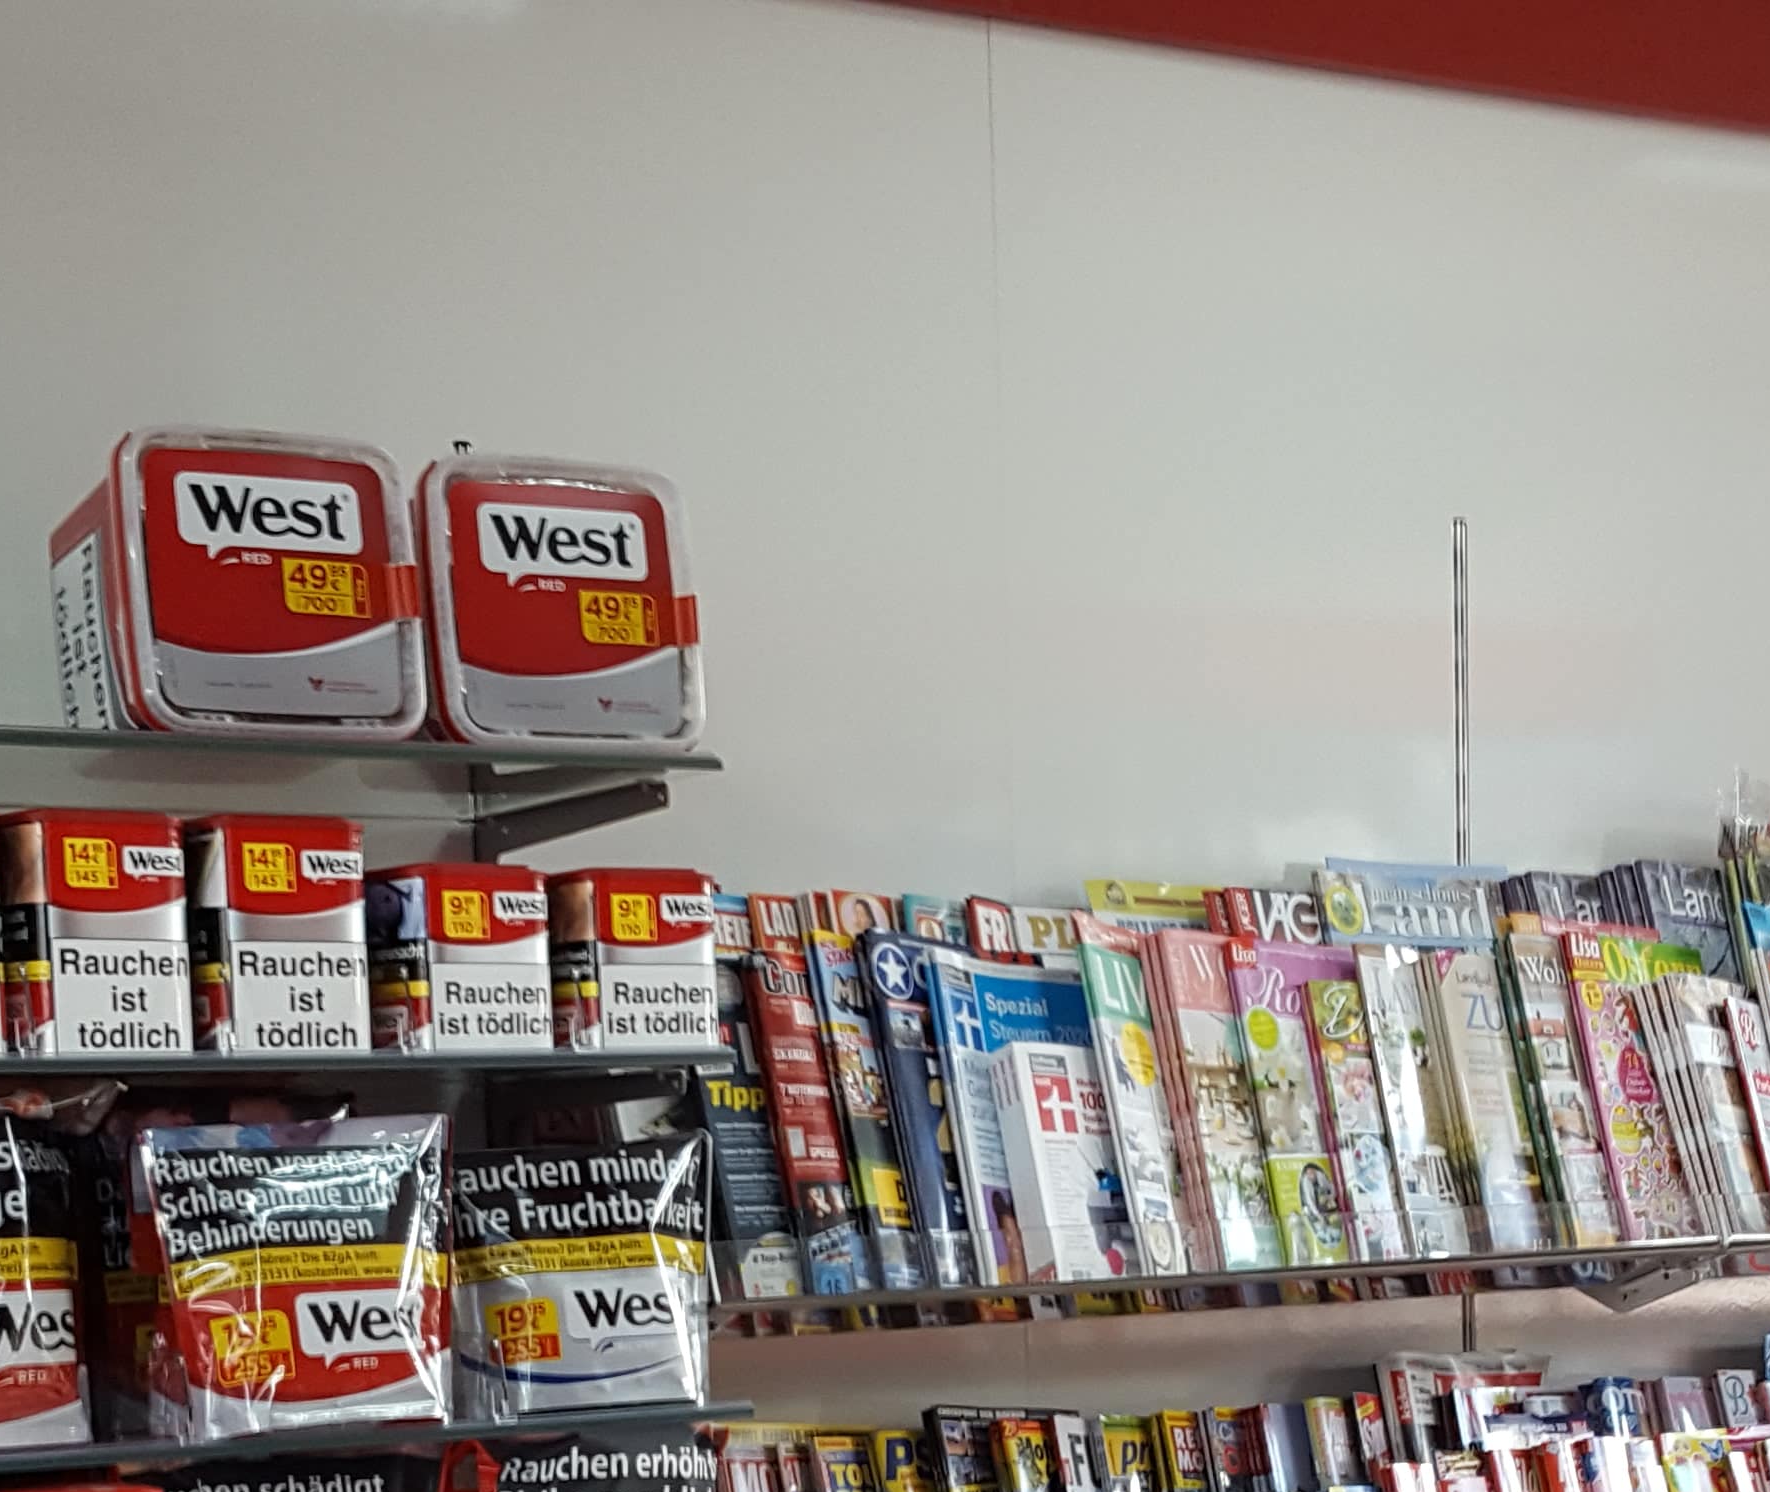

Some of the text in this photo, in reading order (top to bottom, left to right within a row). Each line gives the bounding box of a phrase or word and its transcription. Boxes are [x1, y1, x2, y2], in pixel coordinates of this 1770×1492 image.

[187, 482, 347, 541] West
[489, 513, 634, 569] West
[59, 950, 188, 976] Rauchen
[238, 950, 364, 976] Rauchen
[289, 988, 324, 1012] ist
[446, 982, 547, 1006] Rauchen
[984, 993, 1049, 1018] Spezial
[79, 1023, 180, 1048] tödlich
[258, 1023, 357, 1047] tödlich
[479, 1014, 552, 1035] tödlich
[153, 1153, 271, 1187] Rauchen
[501, 1446, 629, 1484] Rauchen
